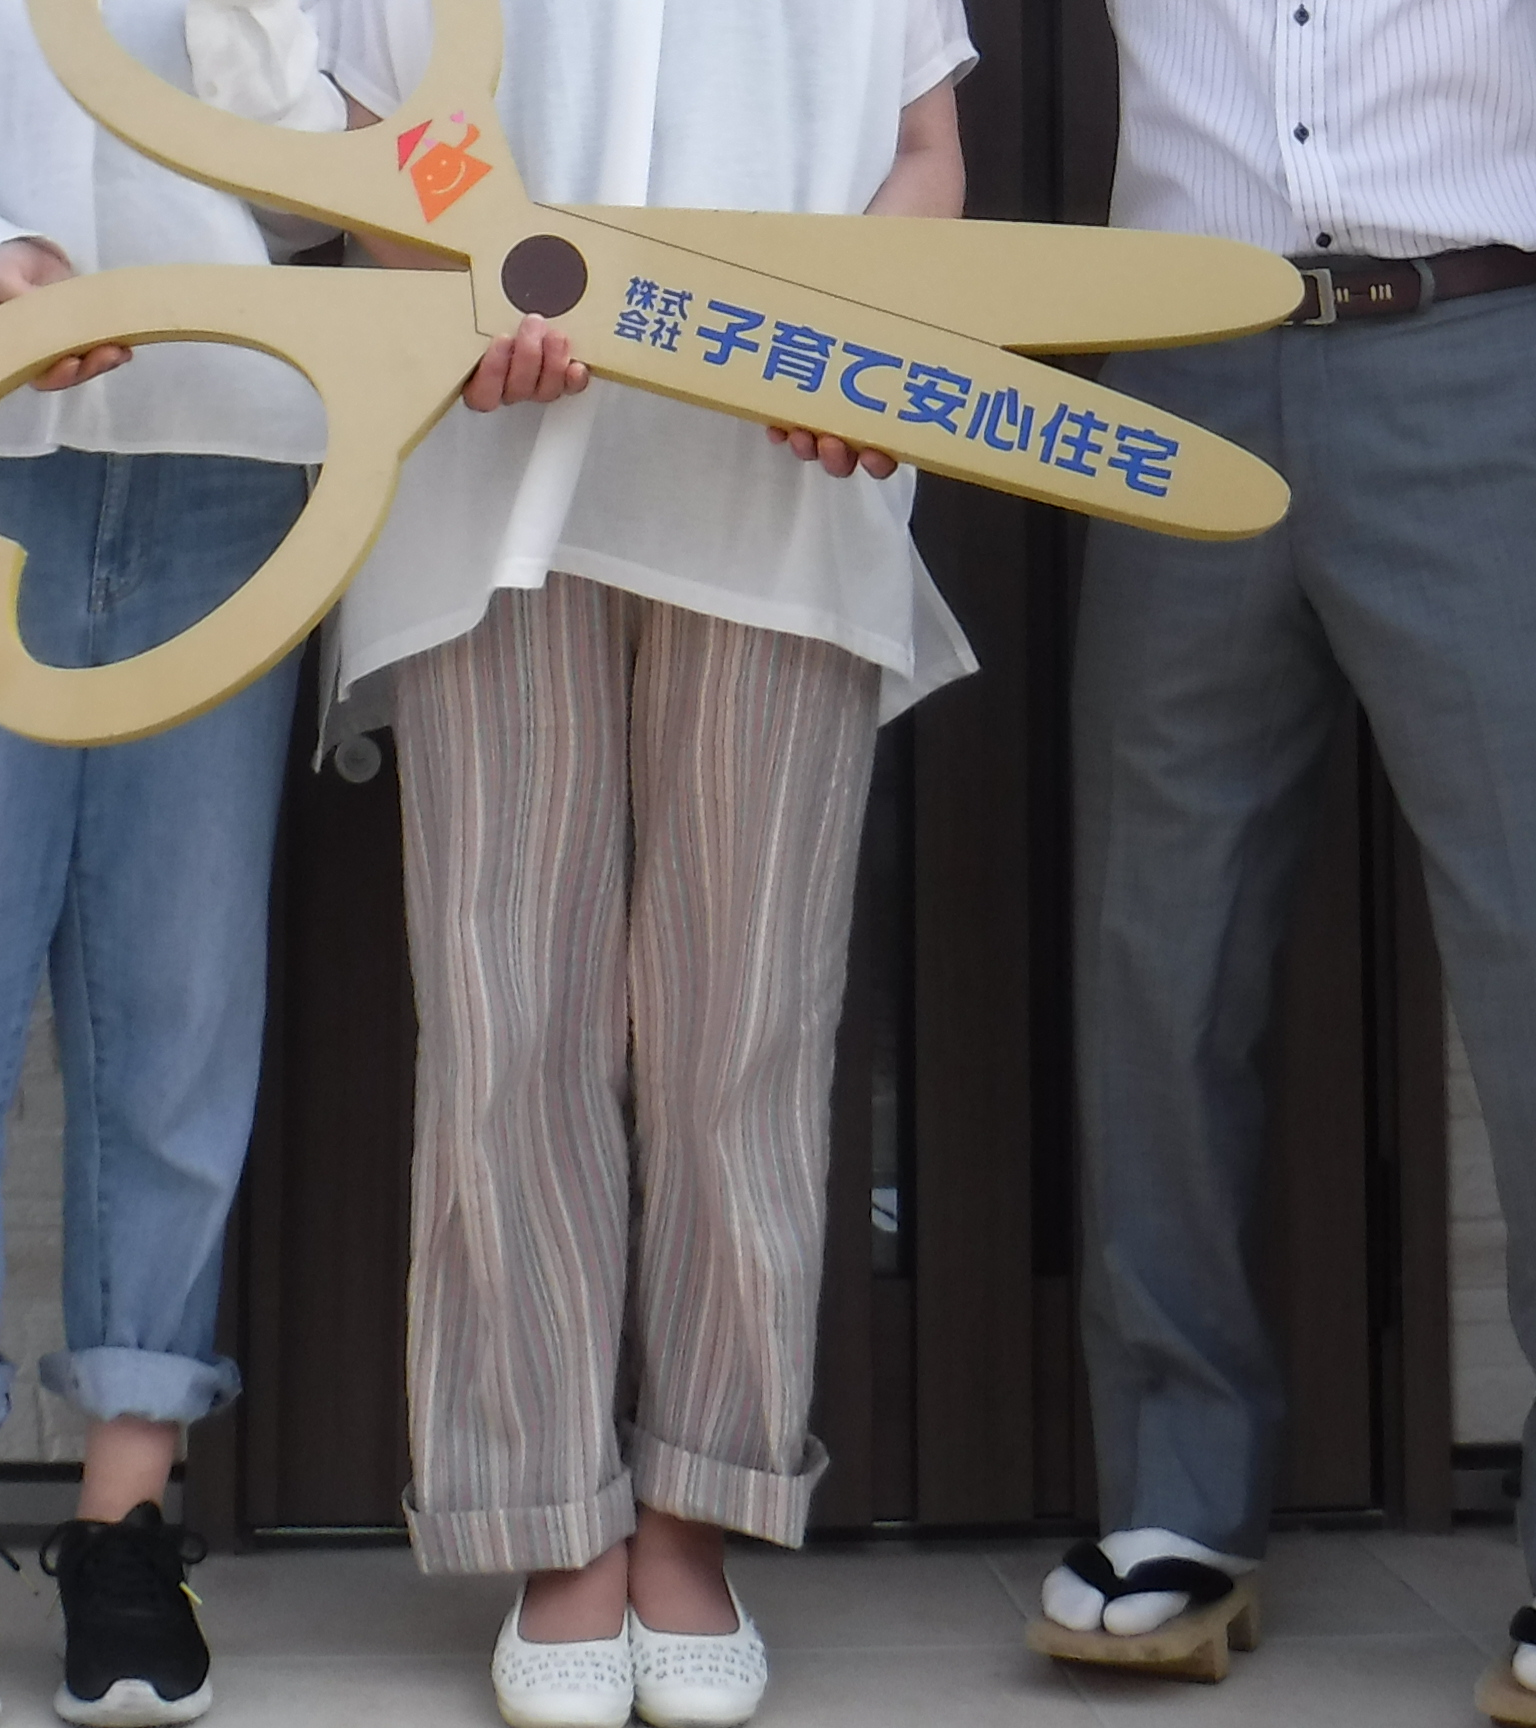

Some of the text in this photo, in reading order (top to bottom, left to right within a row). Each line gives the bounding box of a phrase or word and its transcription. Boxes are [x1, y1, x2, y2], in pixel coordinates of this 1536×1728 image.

[695, 298, 1181, 498] 子育て安心住宅
